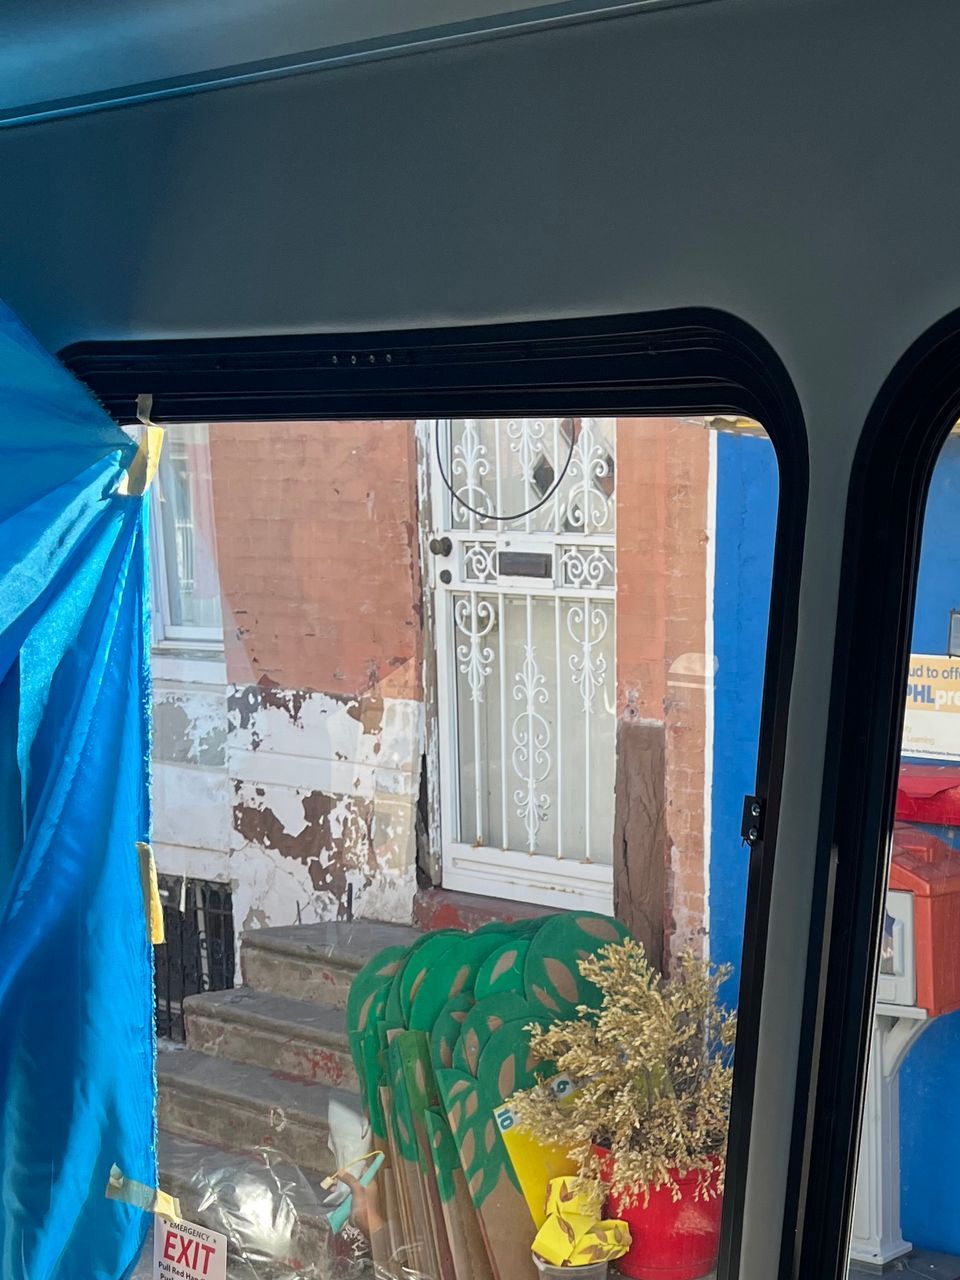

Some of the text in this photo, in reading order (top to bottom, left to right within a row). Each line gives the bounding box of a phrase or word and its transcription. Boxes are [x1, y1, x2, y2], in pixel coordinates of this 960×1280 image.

[927, 666, 938, 678] to
[170, 1220, 210, 1242] EMERGENCY
[164, 1230, 216, 1275] EXIT
[158, 1261, 171, 1272] Pull
[172, 1267, 184, 1277] Red
